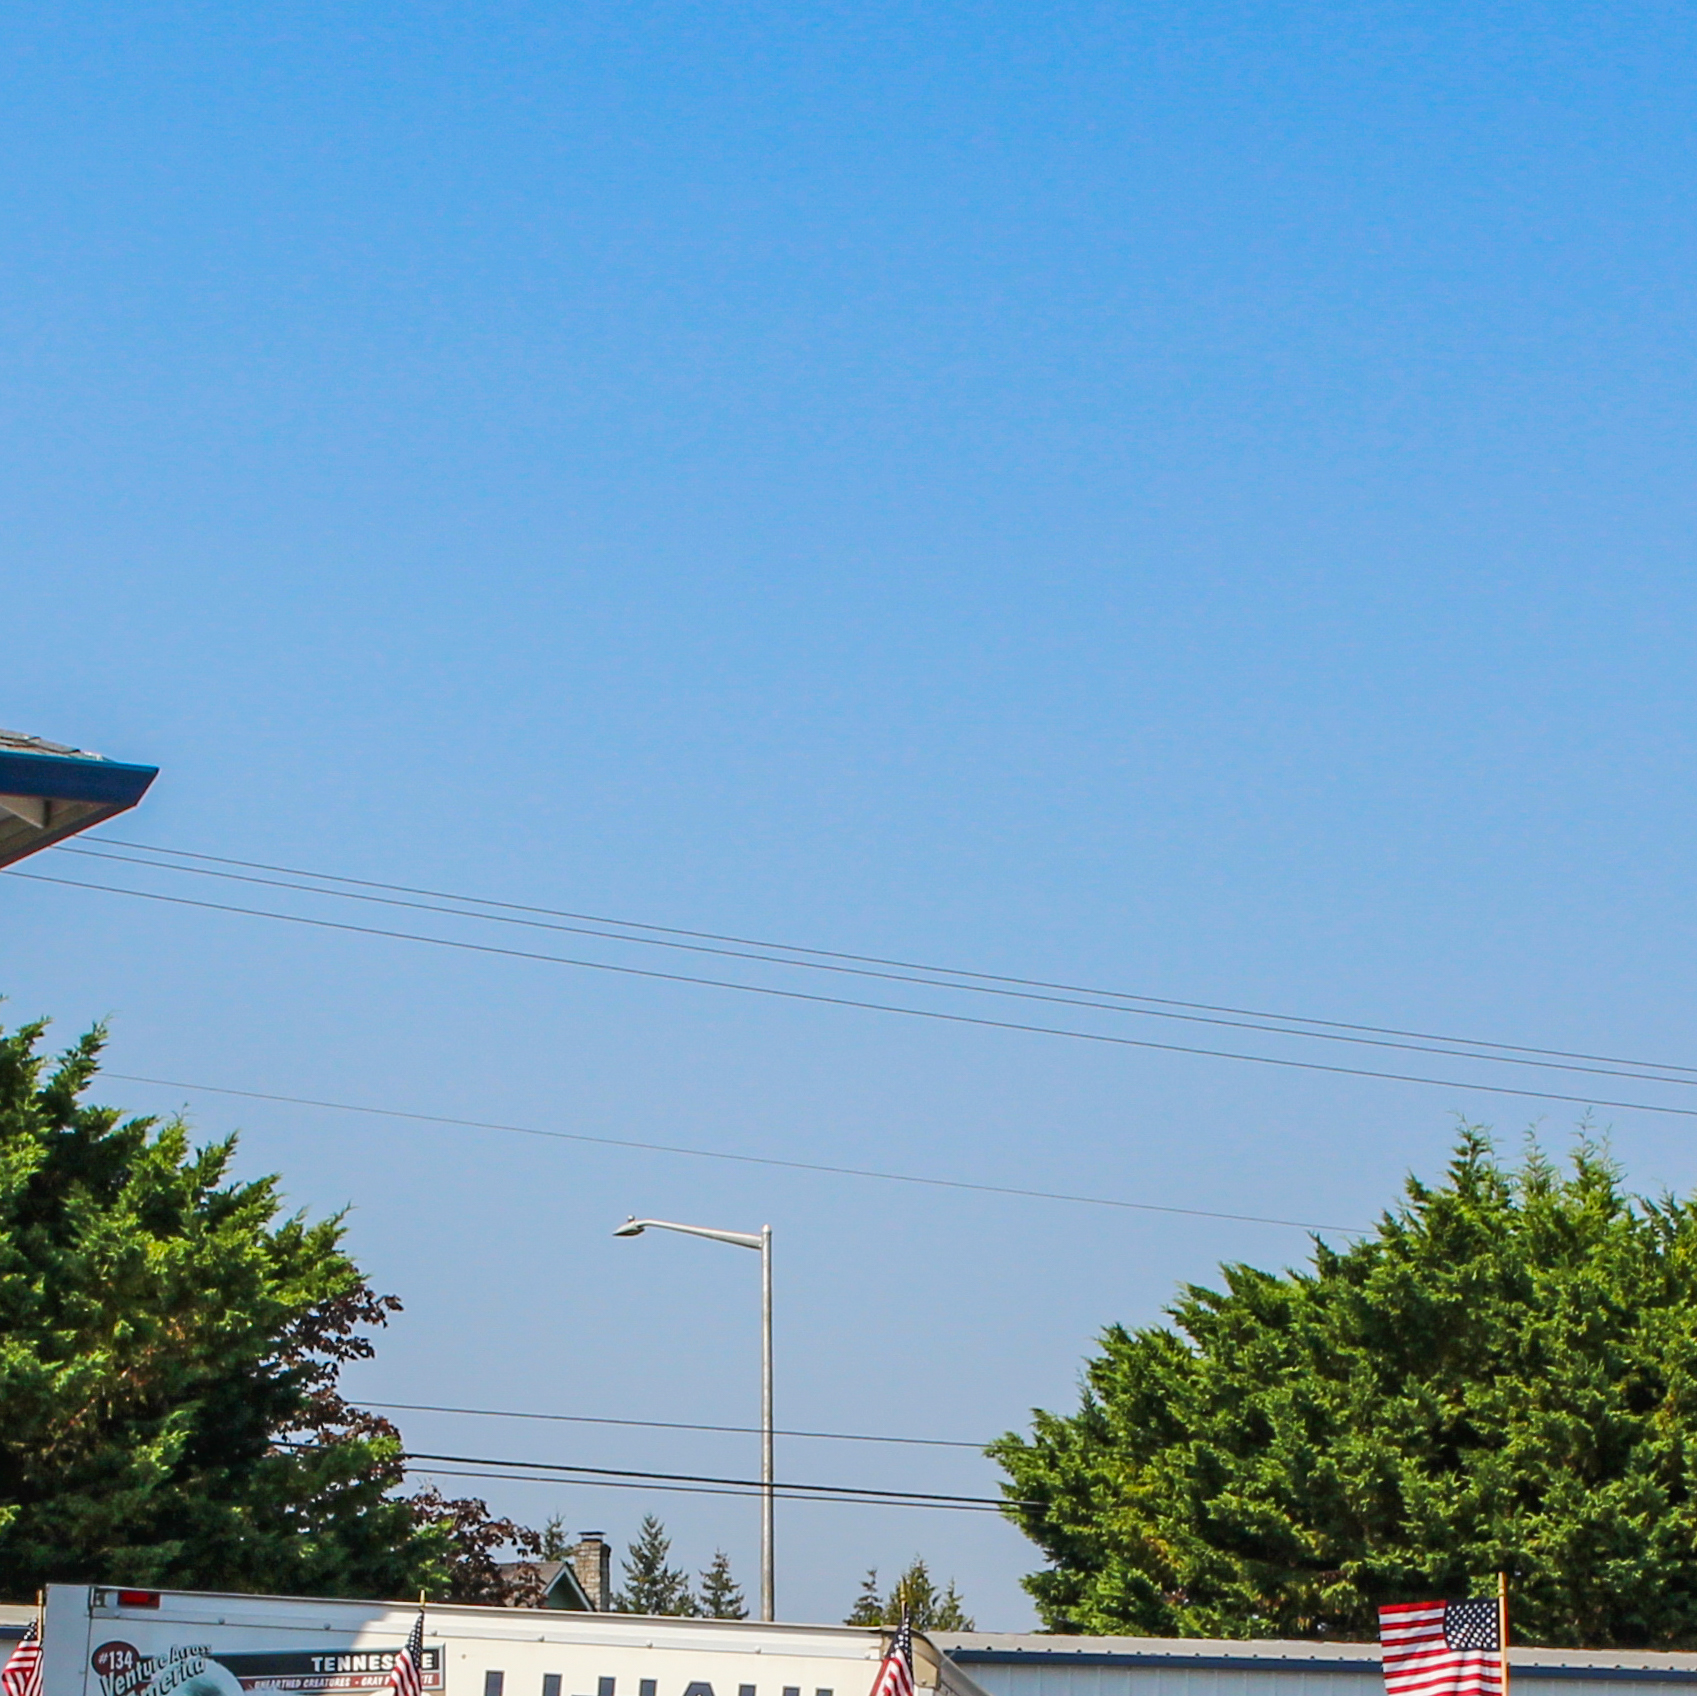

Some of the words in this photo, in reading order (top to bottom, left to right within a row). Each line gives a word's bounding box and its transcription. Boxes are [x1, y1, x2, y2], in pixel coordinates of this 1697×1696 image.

[97, 1650, 134, 1670] #134
[303, 1676, 352, 1688] CREATURES
[361, 1676, 384, 1686] GRAY
